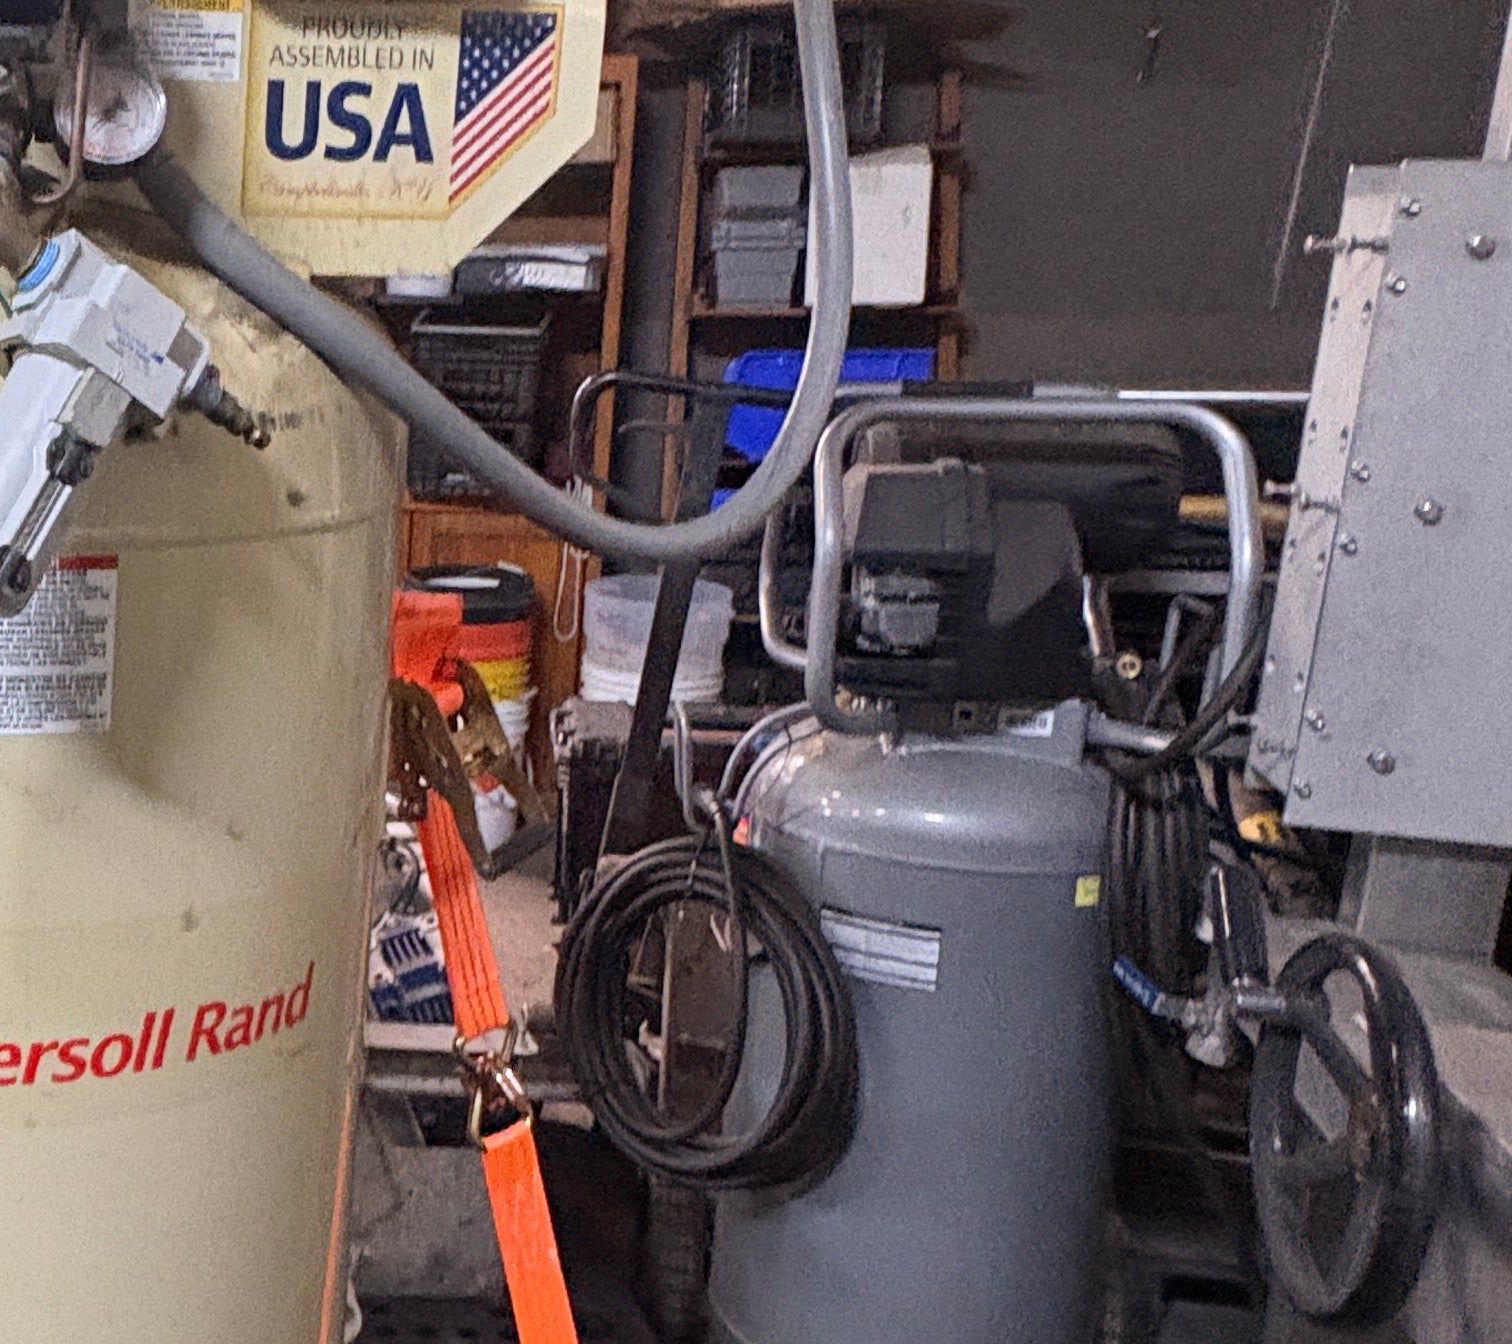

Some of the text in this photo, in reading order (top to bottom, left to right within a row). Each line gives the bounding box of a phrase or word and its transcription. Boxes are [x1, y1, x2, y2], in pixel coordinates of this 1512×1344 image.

[269, 43, 436, 71] ASSEMBLED IN
[302, 16, 404, 41] PROUDLY
[264, 78, 435, 165] USA
[185, 960, 316, 1063] Rand
